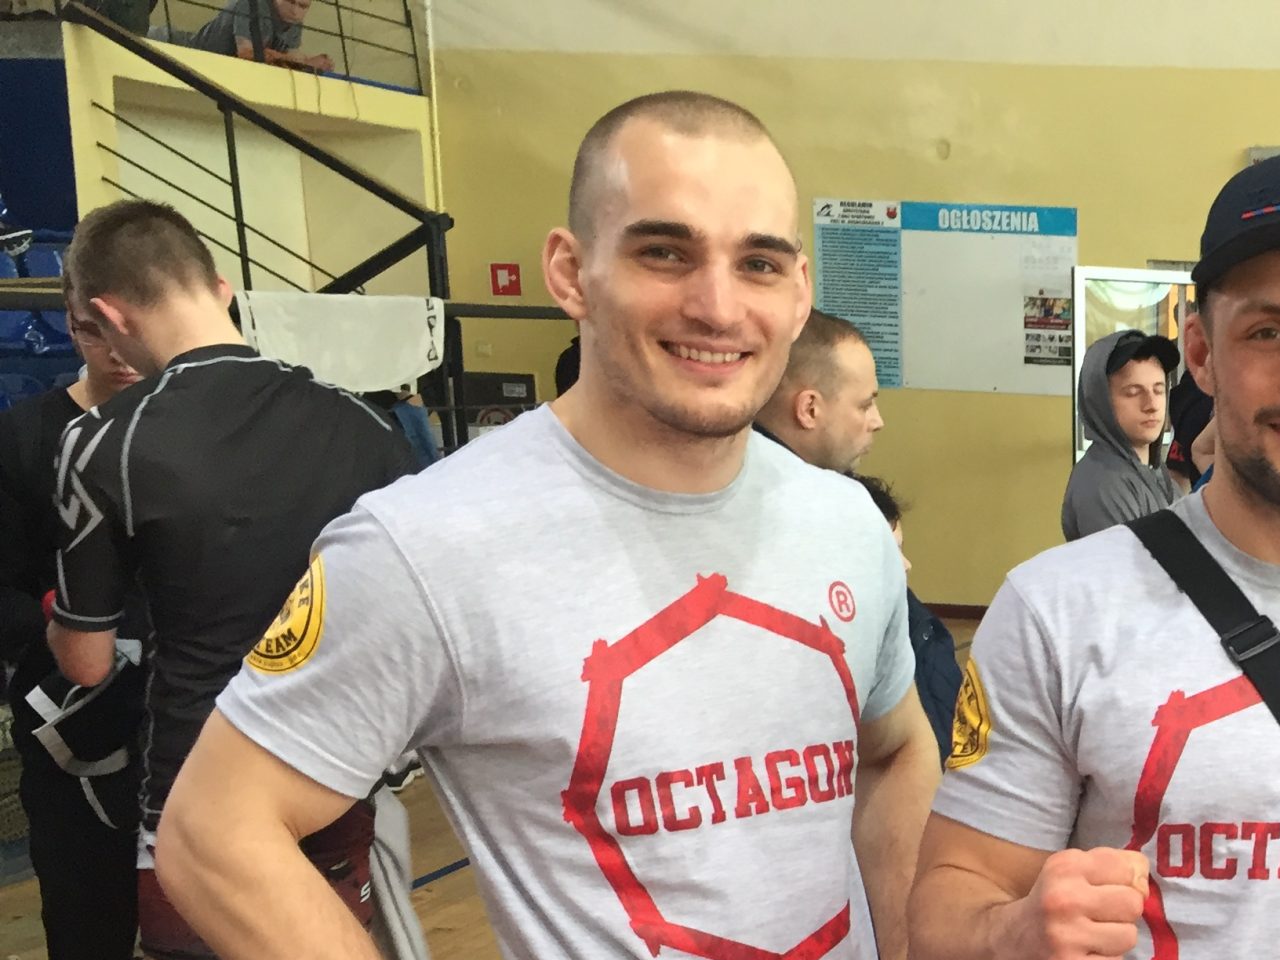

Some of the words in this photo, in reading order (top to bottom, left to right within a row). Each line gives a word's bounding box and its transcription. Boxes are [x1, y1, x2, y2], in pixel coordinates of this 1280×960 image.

[938, 208, 1039, 232] OGŁOSZENIA
[256, 627, 298, 653] EAM
[610, 740, 854, 836] OCTAGON
